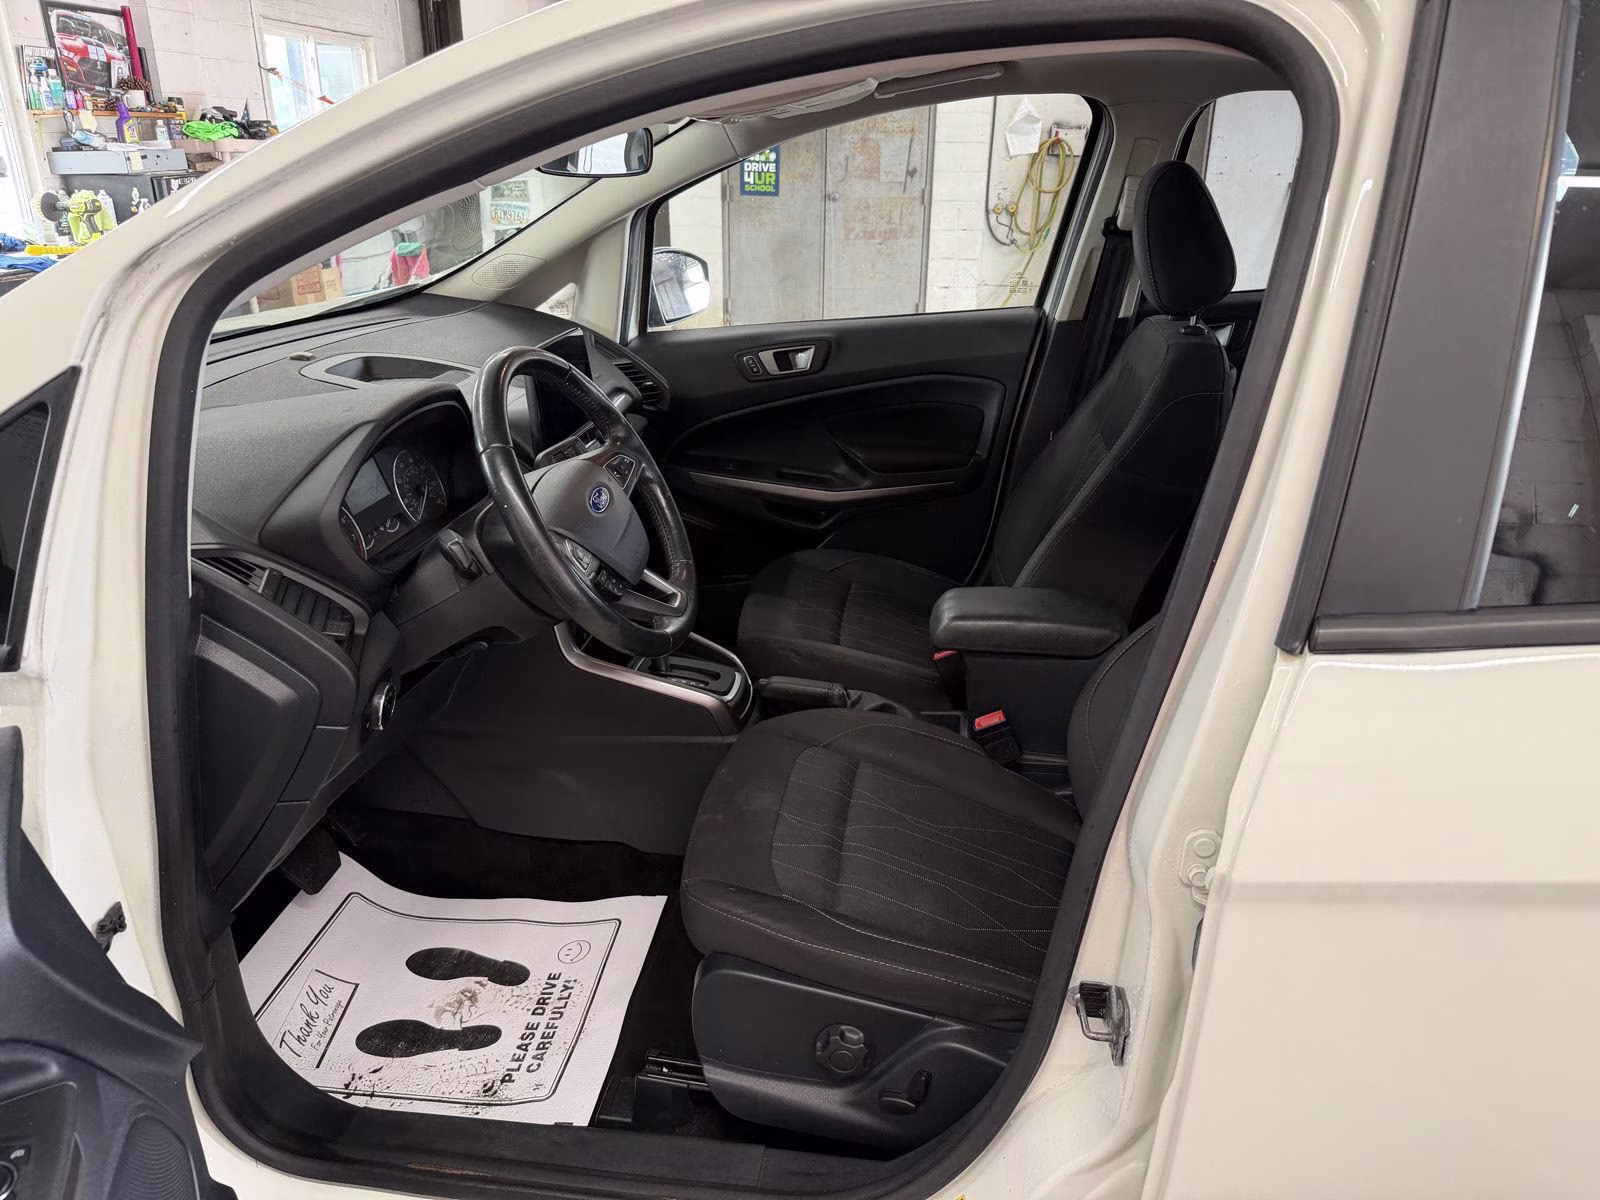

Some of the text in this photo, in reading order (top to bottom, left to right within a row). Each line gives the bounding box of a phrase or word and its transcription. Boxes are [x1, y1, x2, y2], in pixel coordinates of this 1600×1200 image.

[743, 161, 777, 173] DRIVE
[743, 171, 776, 185] 4UR
[743, 184, 776, 193] SCHOOL
[279, 983, 335, 1058] Thank You
[500, 971, 562, 1085] PLEASE DRIVE
